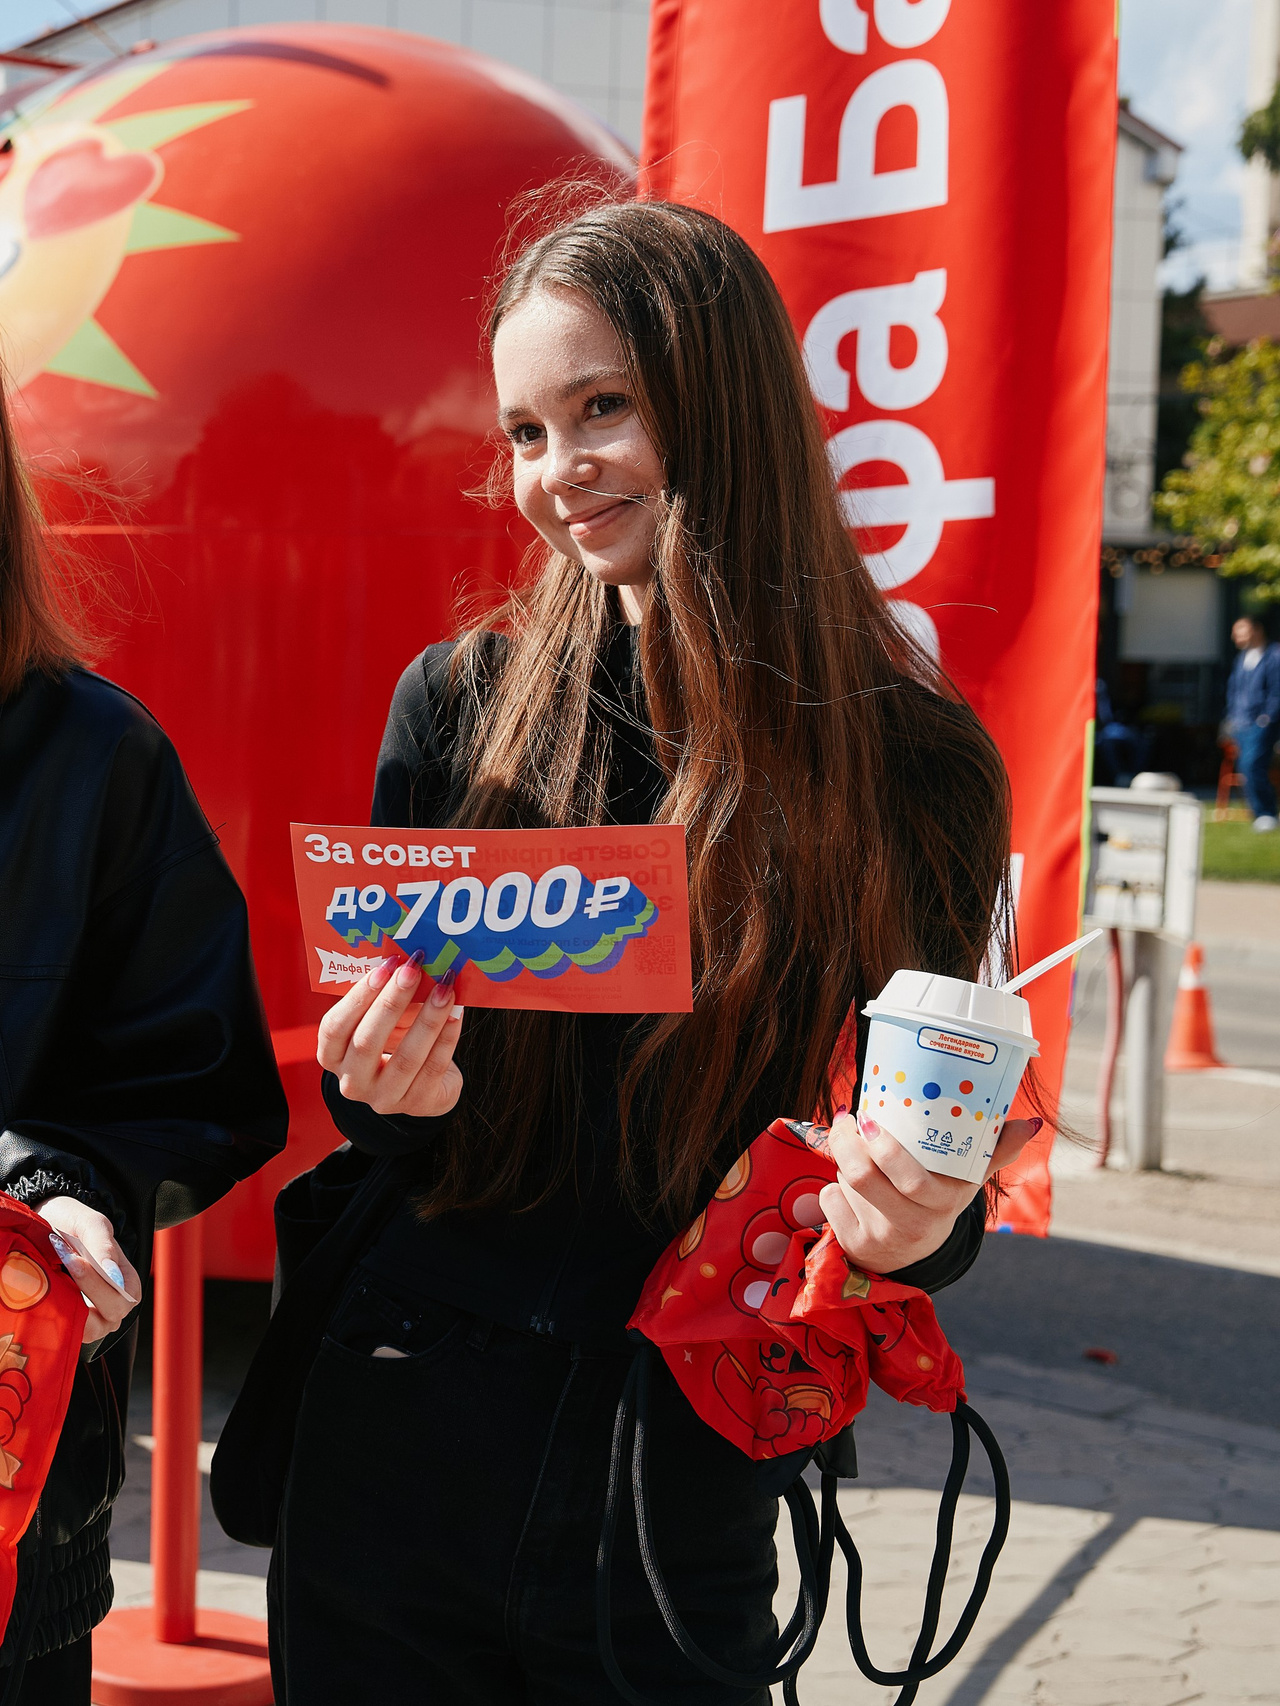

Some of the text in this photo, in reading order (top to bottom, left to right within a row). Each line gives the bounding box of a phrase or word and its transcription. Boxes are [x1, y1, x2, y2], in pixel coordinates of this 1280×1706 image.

[304, 834, 476, 868] За совет
[325, 884, 386, 921] до
[392, 865, 582, 940] 7000
[583, 876, 631, 919] ₽
[328, 960, 363, 975] Альфа
[929, 1040, 985, 1059] сочетание вкусов
[938, 1033, 980, 1050] Легендарное
